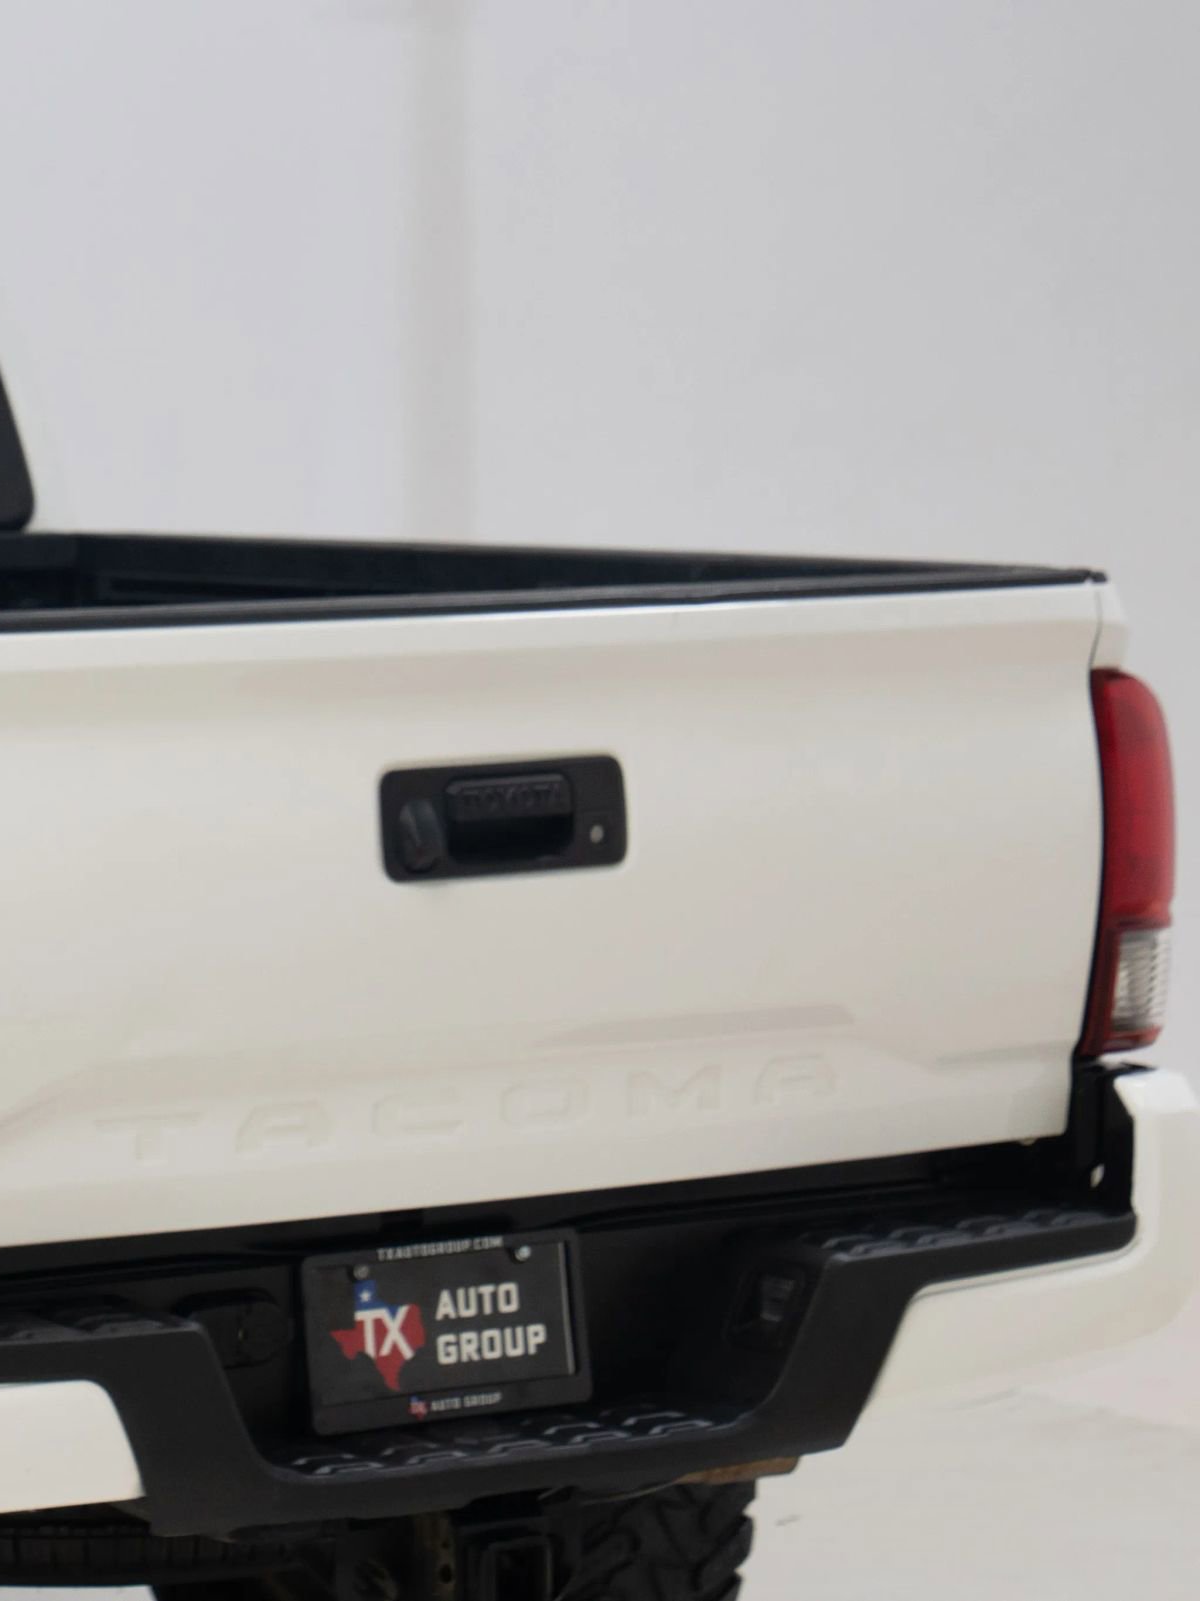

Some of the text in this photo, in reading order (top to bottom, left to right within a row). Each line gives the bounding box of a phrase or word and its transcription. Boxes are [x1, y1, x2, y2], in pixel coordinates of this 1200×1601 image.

[91, 1051, 840, 1168] TACOMA
[376, 1234, 504, 1262] TXAUTOGROUP.COM
[435, 1282, 520, 1321] AUTO
[354, 1303, 416, 1361] TX
[435, 1323, 547, 1366] GROUP
[430, 1396, 461, 1412] AUTO
[462, 1391, 502, 1408] GROUP
